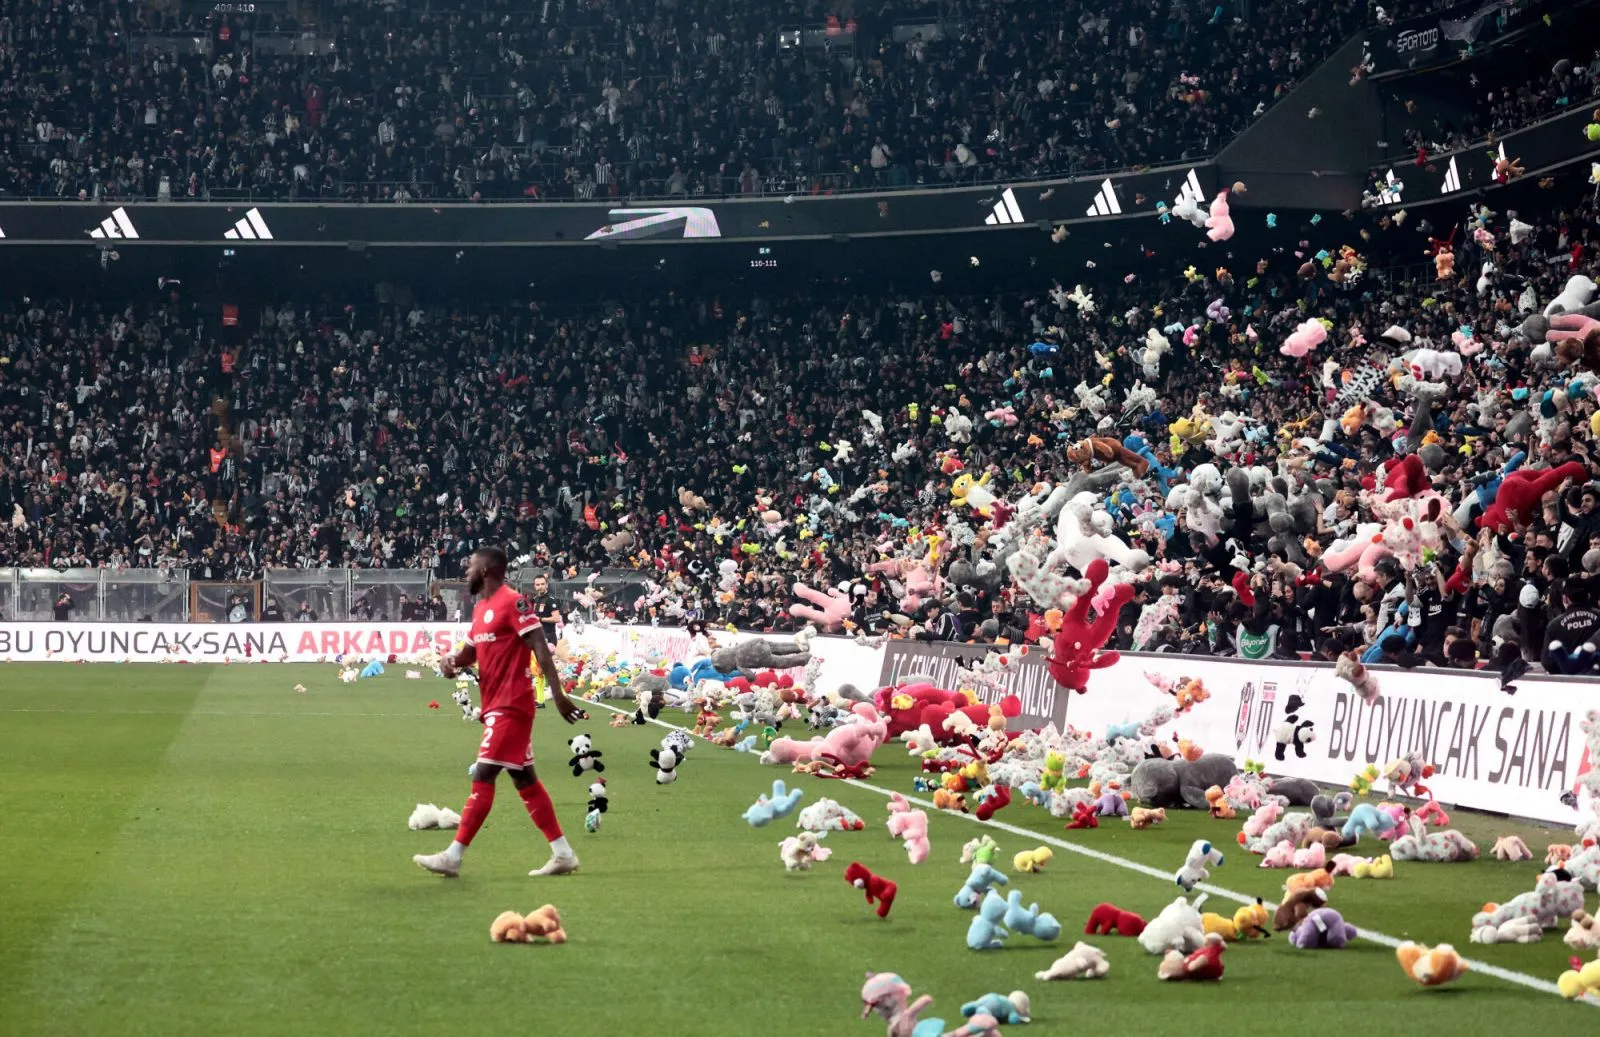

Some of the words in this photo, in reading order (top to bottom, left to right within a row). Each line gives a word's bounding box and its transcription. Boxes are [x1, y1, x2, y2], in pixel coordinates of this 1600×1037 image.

[0, 631, 33, 653] BU
[45, 631, 192, 654] OYUNCAK
[203, 631, 287, 655] SANA
[480, 727, 494, 748] 2
[1328, 692, 1363, 761] BU
[1364, 695, 1491, 780] OYUNCAK
[1488, 707, 1571, 790] SANA
